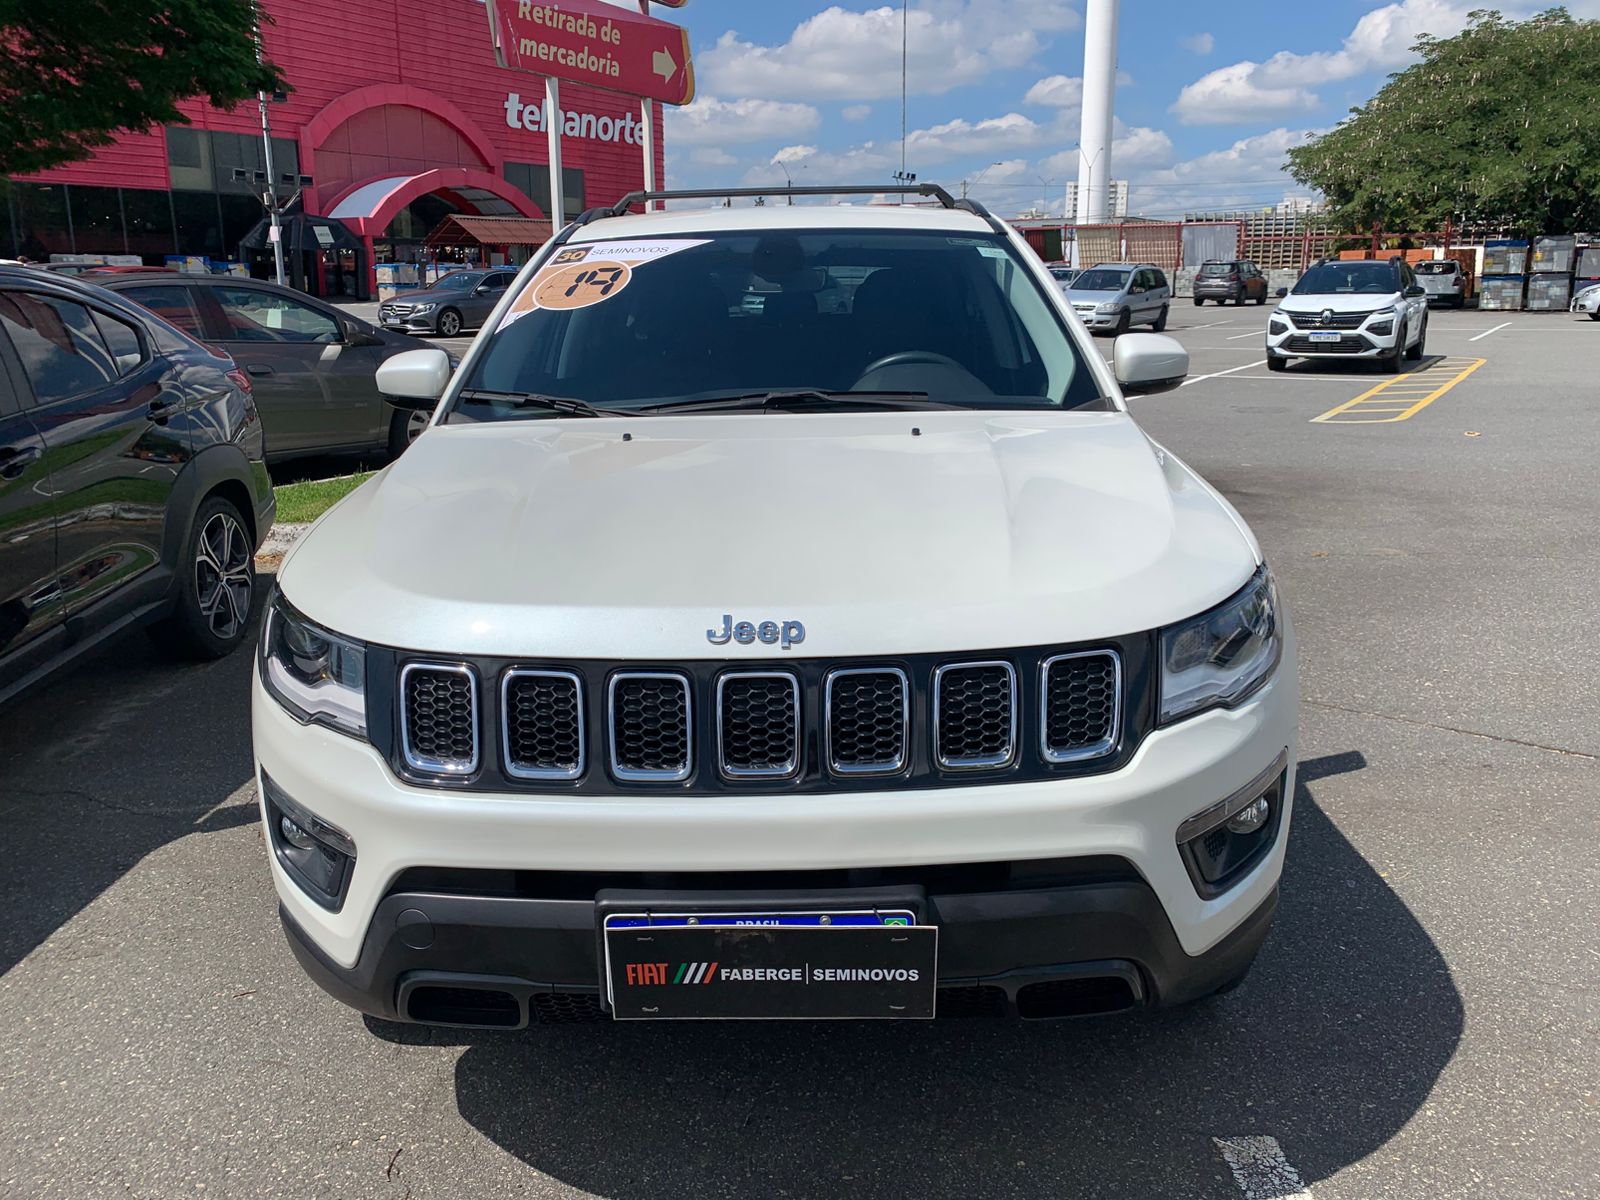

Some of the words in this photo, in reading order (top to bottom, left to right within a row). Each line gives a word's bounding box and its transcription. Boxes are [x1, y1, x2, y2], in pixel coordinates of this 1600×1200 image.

[518, 0, 597, 39] Retirada
[600, 19, 621, 45] de
[519, 37, 620, 77] mercadoria
[591, 246, 670, 256] SEMINOVOS
[564, 267, 624, 298] 19
[706, 614, 806, 650] Jeep
[626, 962, 668, 986] FIAT
[721, 968, 802, 982] FABERGE
[813, 968, 920, 982] SEMINOVOS
